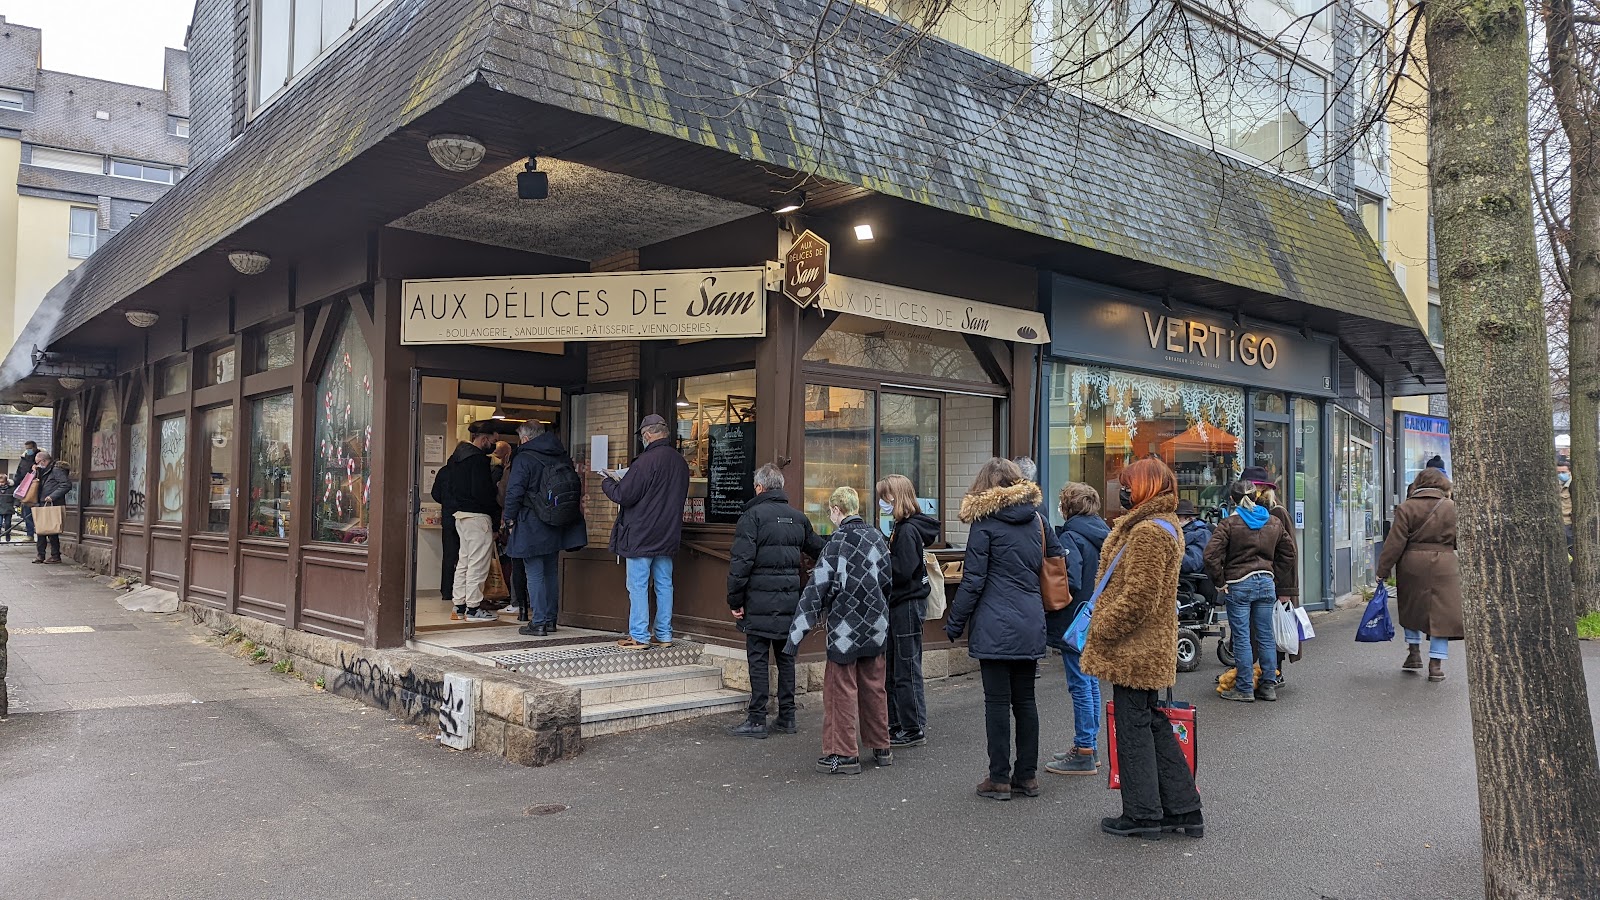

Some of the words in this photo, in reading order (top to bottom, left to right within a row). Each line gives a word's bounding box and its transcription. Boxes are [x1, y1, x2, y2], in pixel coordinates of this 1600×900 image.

[801, 241, 813, 250] AUX
[815, 248, 823, 257] DE
[790, 261, 820, 286] Sam
[410, 293, 467, 320] AUX
[485, 286, 610, 319] DÉLICES
[632, 288, 667, 316] DE
[686, 276, 756, 317] Sam
[822, 288, 856, 311] AUX
[864, 293, 928, 323] DÉLICES
[936, 308, 953, 328] DE
[961, 306, 991, 333] Sam
[446, 328, 508, 338] BOULANGERIE
[515, 325, 579, 336] SANDWICHERIE
[586, 323, 635, 335] PÂTISSERIE
[642, 322, 711, 334] VIENNOISERIES
